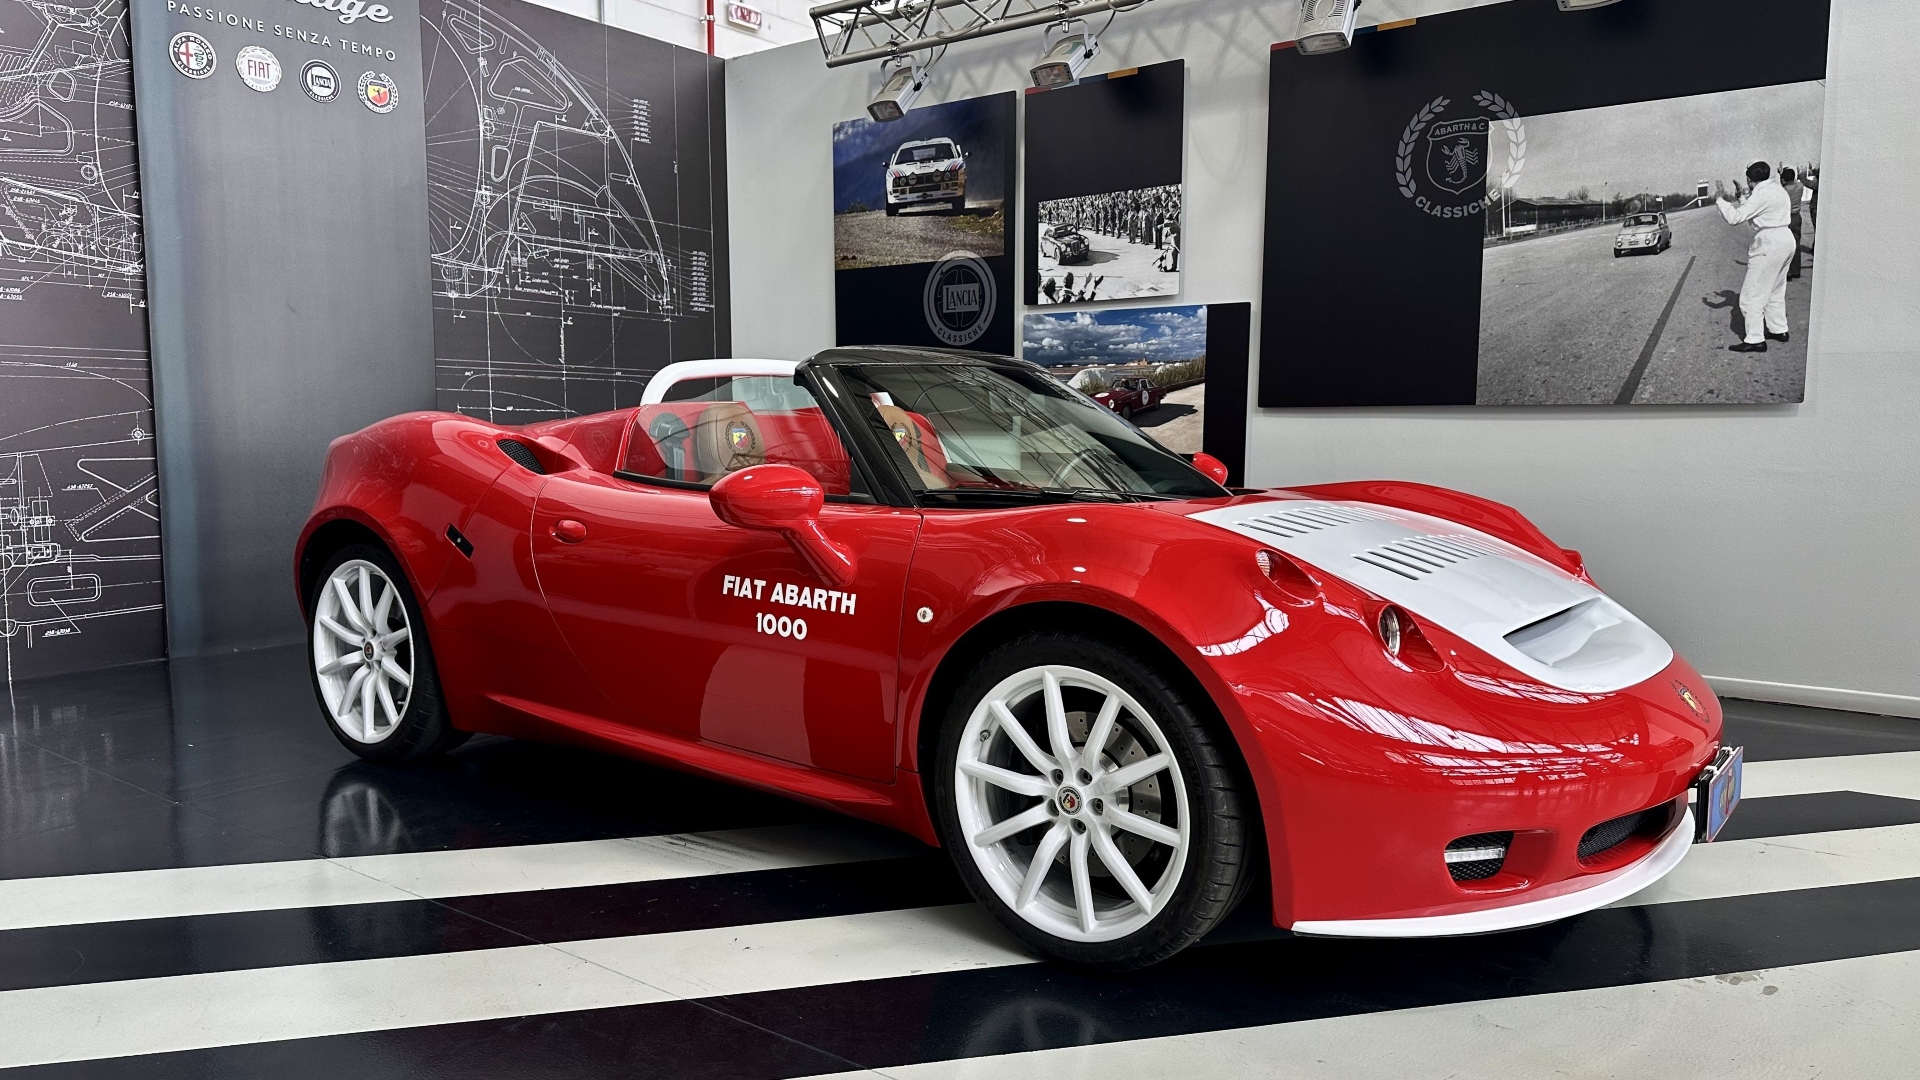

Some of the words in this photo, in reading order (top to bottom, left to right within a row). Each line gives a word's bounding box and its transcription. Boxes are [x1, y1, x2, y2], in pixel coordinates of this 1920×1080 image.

[167, 0, 264, 32] PASSIONE
[274, 24, 331, 47] SENZA
[339, 39, 396, 61] TEMPO
[173, 36, 187, 53] ALFA
[190, 36, 213, 60] ROMEO
[247, 59, 270, 79] FIAT
[1434, 123, 1470, 136] ABARTH
[1415, 188, 1502, 218] CLASSICHE
[945, 287, 978, 311] LANCIA
[937, 324, 983, 343] CLASSICHE
[723, 574, 766, 600] FIAT
[770, 582, 857, 615] ABARTH
[756, 612, 808, 640] 1000
[1167, 720, 1204, 798] MICHELIN
